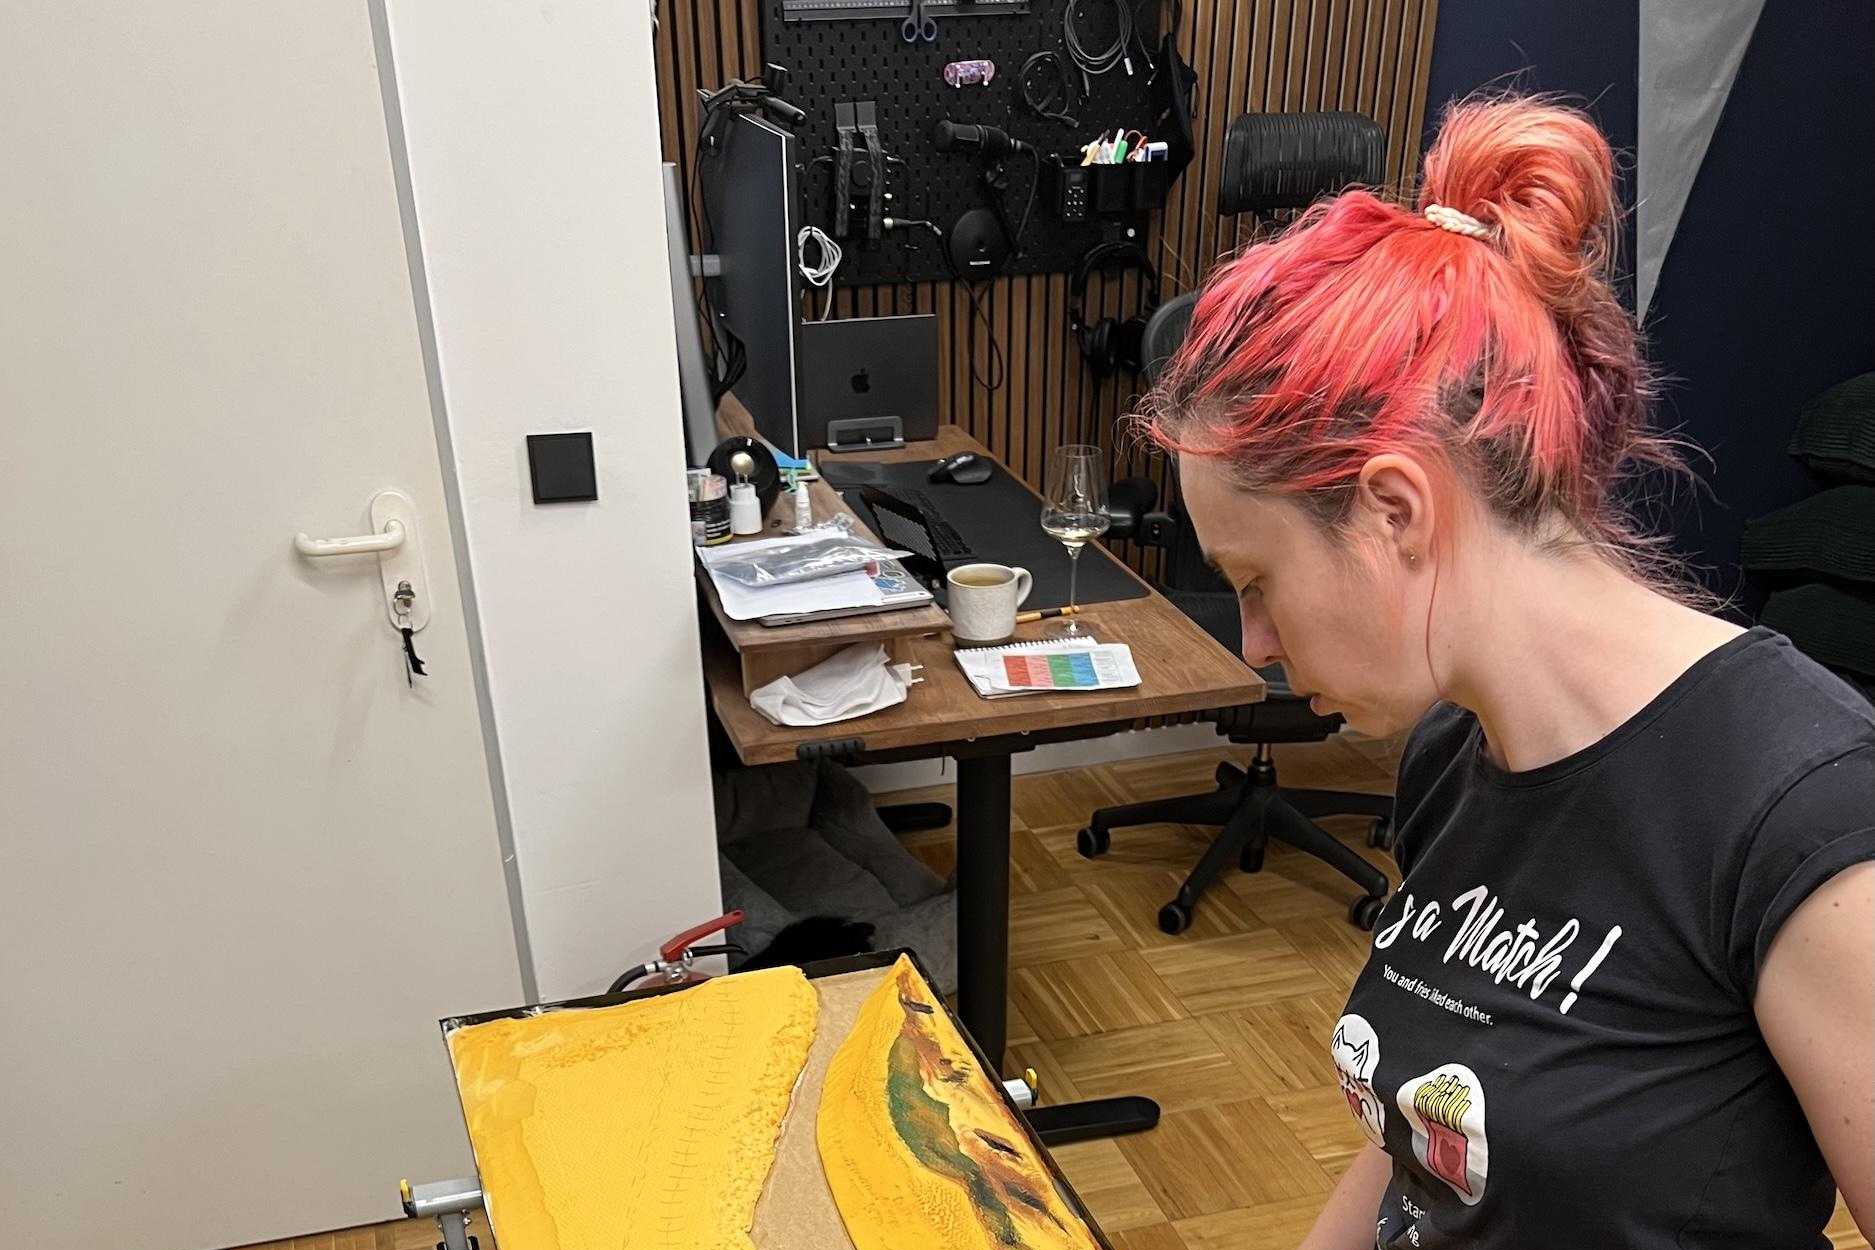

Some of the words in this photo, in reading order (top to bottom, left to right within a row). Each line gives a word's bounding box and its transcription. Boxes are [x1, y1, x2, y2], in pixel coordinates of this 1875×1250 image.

[1412, 900, 1442, 942] a
[1383, 964, 1399, 983] You
[1397, 975, 1418, 992] and
[1444, 998, 1463, 1015] each
[1463, 1006, 1494, 1026] other.
[1402, 1195, 1426, 1220] Star
